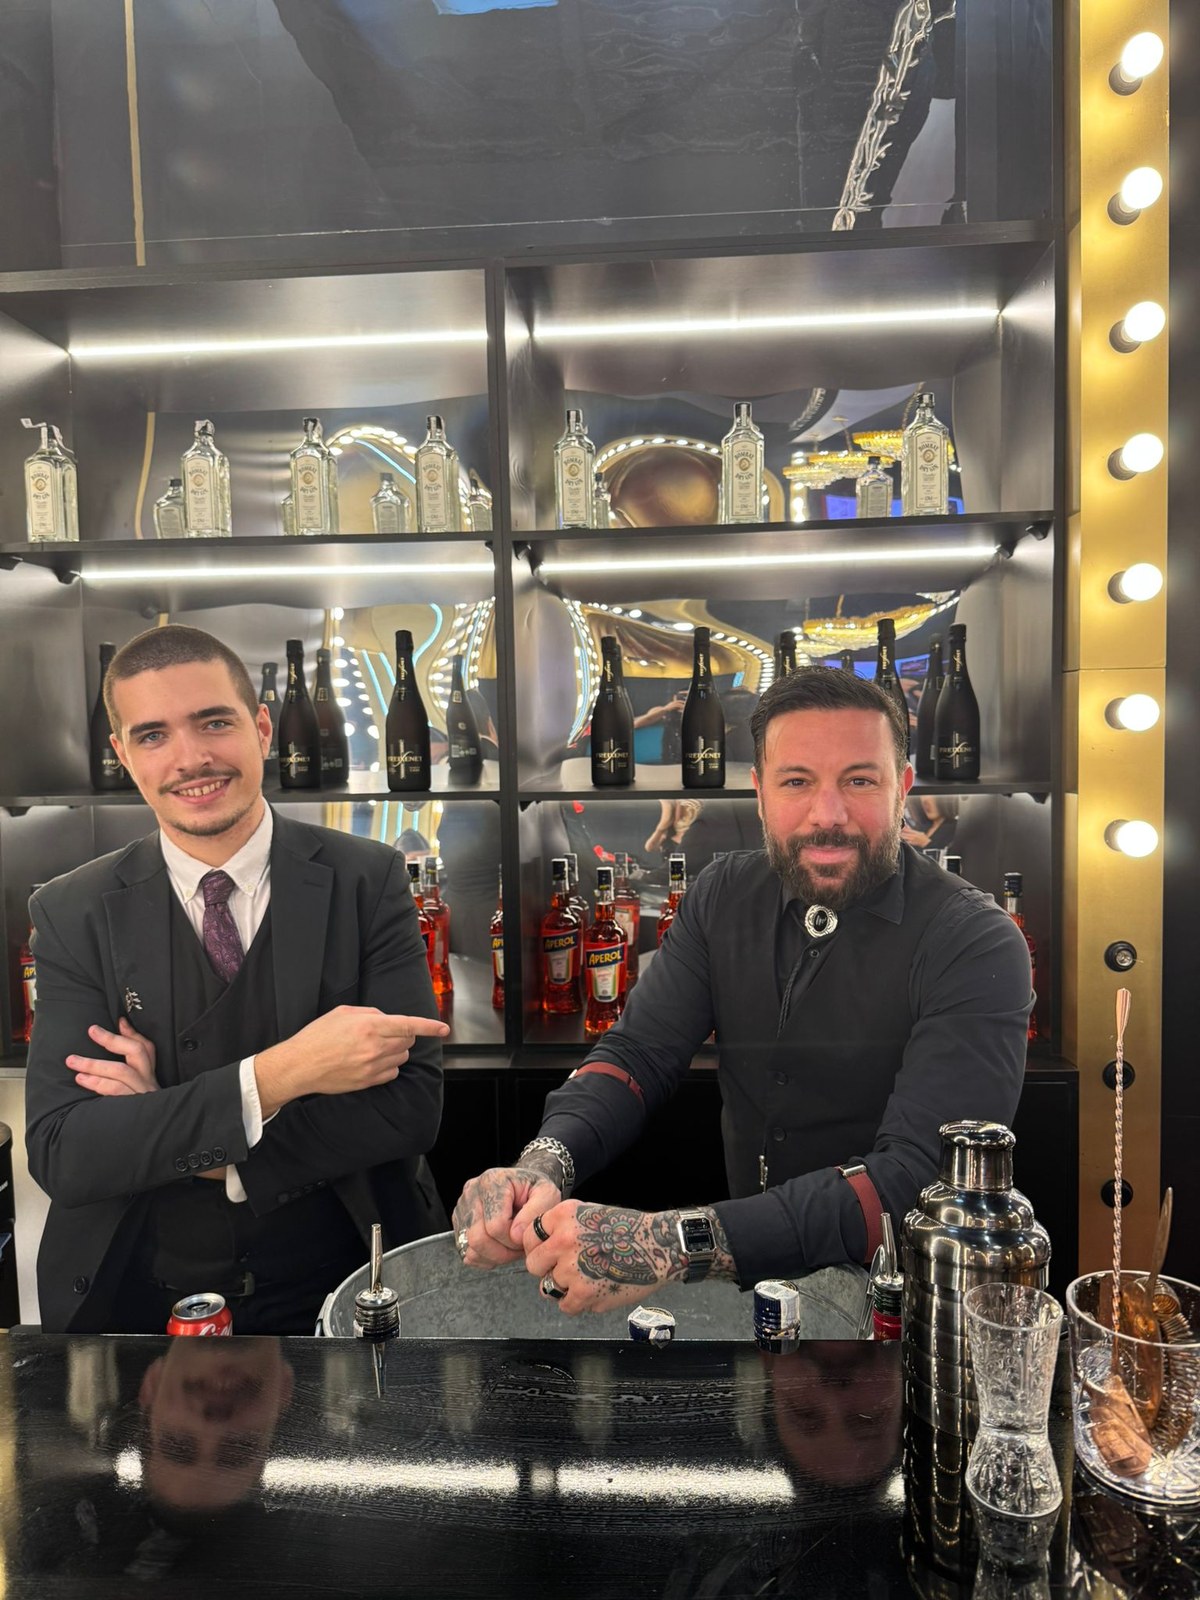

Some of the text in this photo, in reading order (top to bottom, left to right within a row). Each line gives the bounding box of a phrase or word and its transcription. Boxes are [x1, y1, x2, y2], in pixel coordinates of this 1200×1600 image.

[918, 443, 939, 451] BOMBAY
[545, 936, 575, 949] APEROL
[589, 950, 622, 966] APEROL
